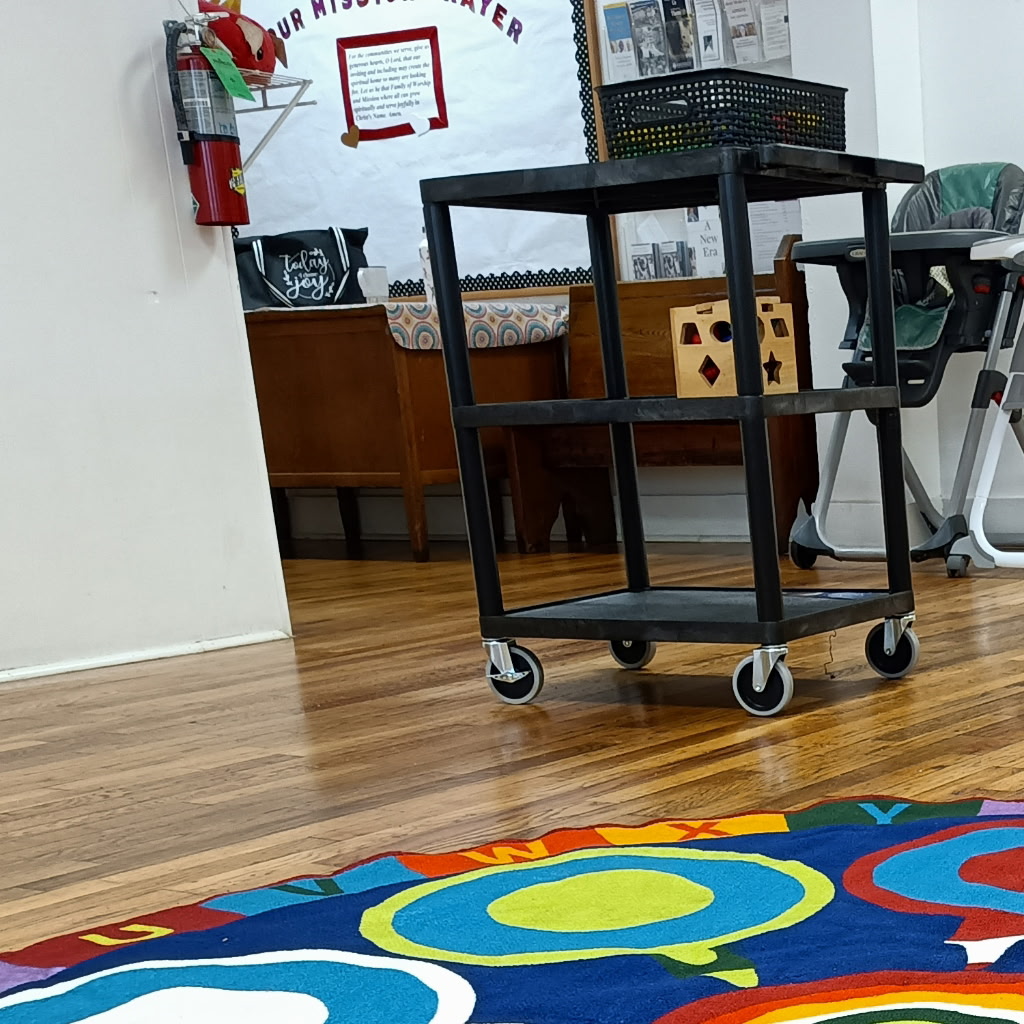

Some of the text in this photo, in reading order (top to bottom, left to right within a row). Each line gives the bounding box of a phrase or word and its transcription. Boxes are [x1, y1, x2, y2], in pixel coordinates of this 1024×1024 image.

[704, 220, 711, 231] A
[700, 234, 718, 244] New
[703, 247, 718, 257] Era
[286, 275, 329, 301] joy
[79, 923, 175, 945] U
[271, 877, 345, 896] V
[464, 839, 549, 865] W
[677, 821, 732, 839] X
[857, 803, 911, 825] Y
